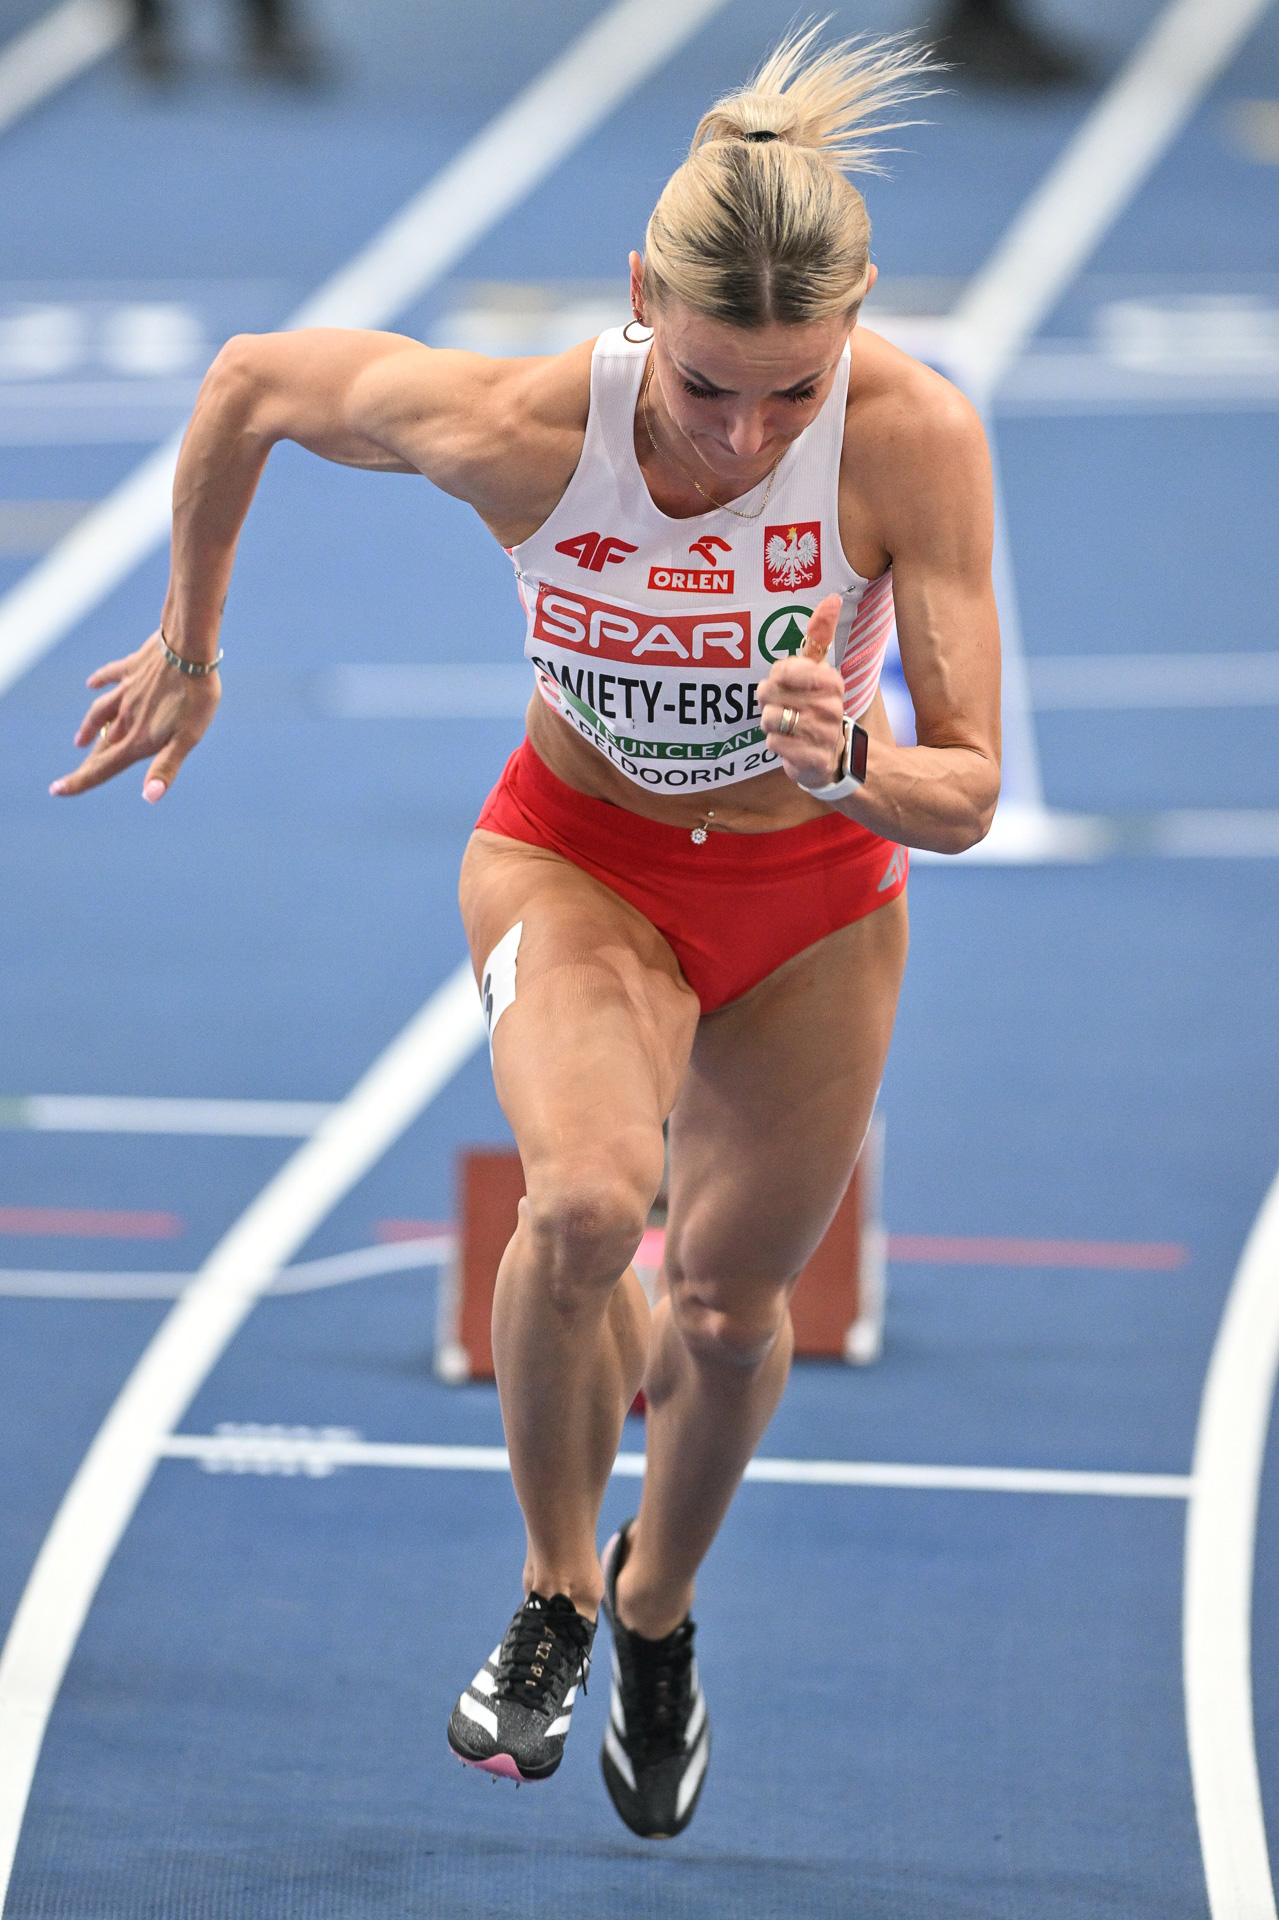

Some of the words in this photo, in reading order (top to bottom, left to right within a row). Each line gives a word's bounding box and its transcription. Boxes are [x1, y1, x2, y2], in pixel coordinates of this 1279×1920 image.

[555, 532, 639, 572] 4F
[653, 571, 729, 590] ORLEN
[542, 594, 744, 660] SPAR
[531, 656, 762, 724] SWIETY-ERSE
[565, 709, 735, 786] APELDOORN
[744, 749, 779, 771] 20
[604, 728, 658, 757] RUN
